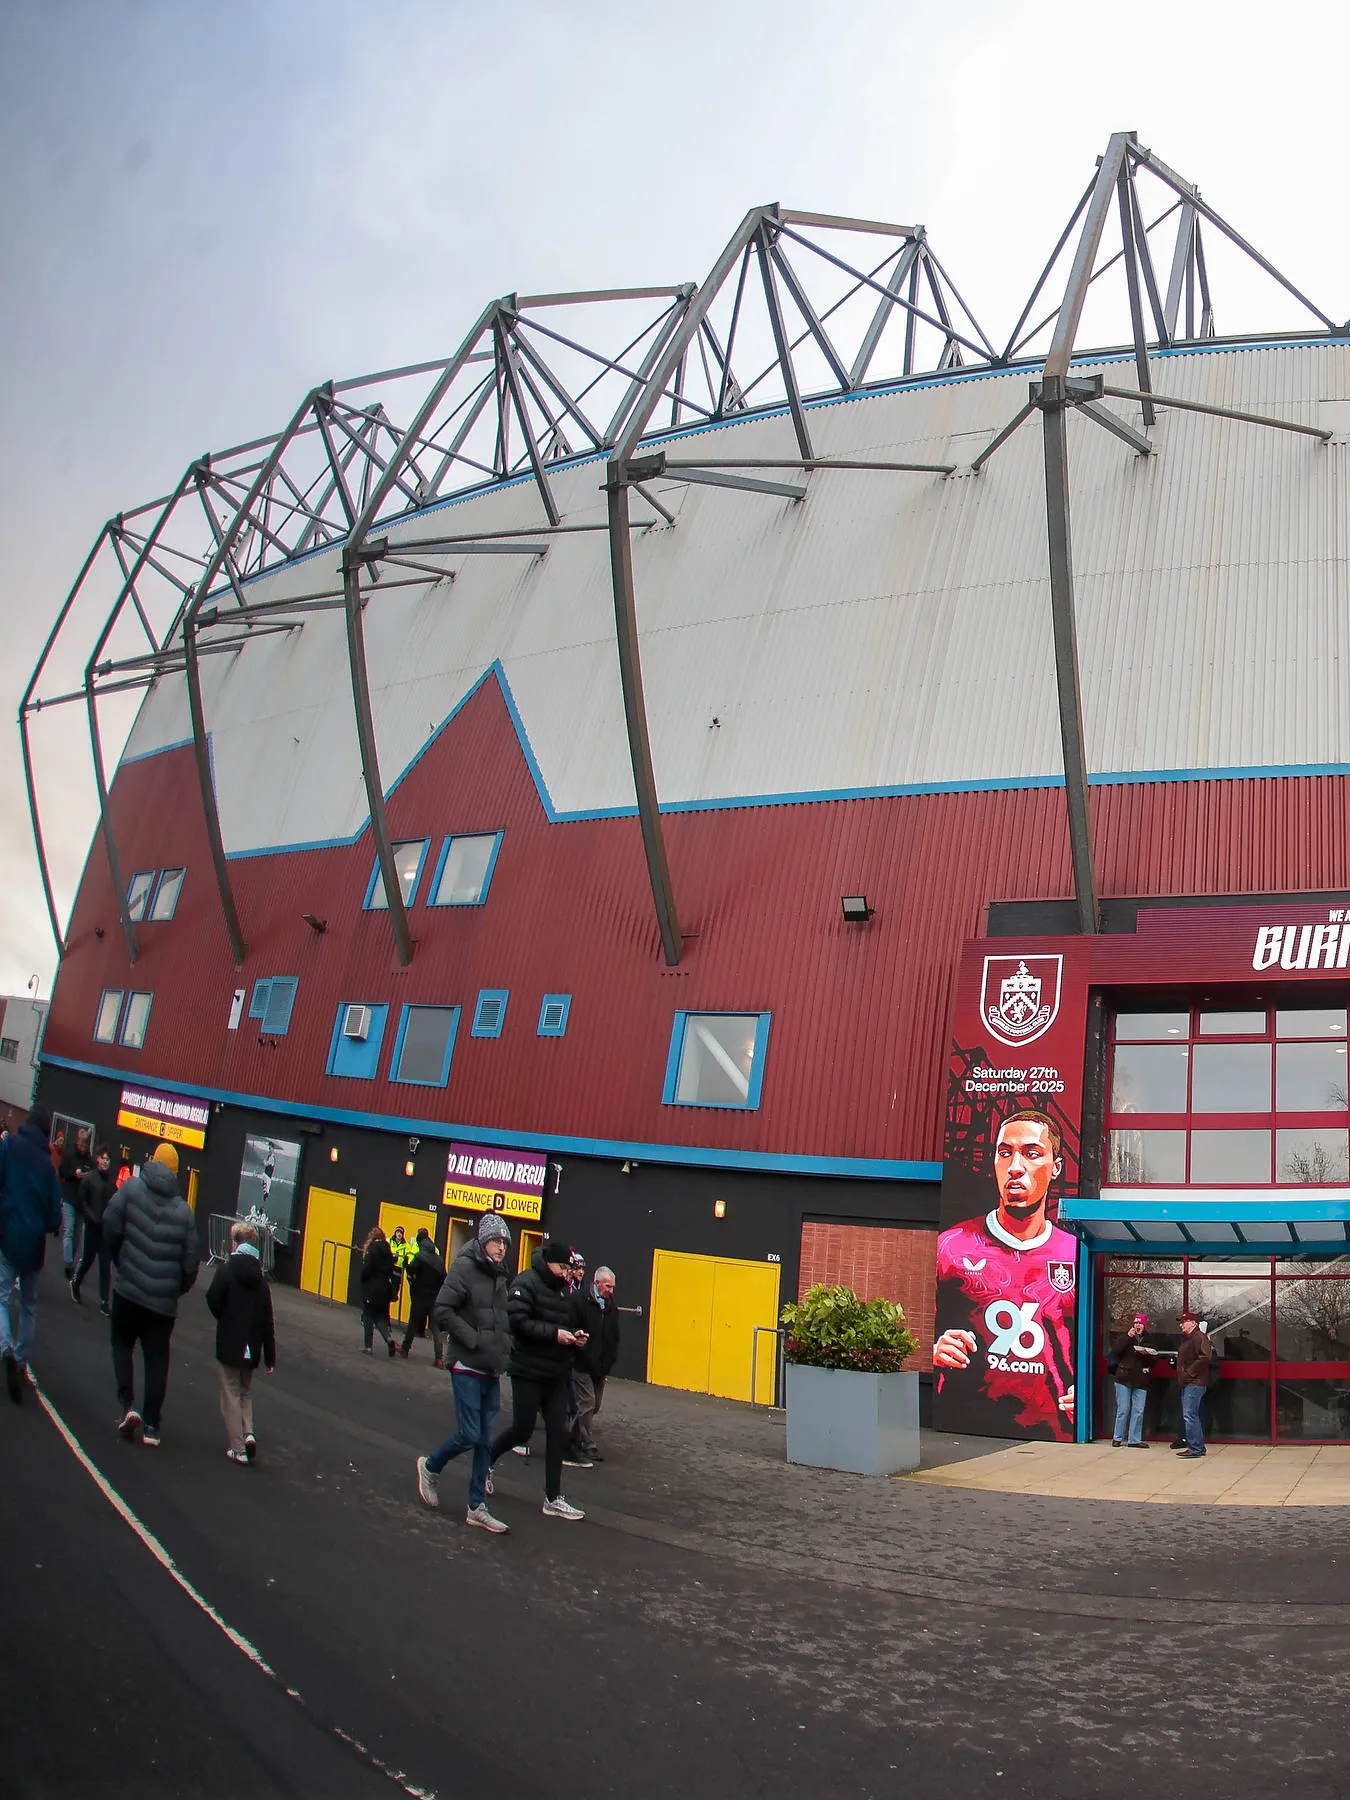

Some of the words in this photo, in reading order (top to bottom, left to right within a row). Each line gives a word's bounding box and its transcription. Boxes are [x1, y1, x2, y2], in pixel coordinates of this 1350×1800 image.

[1329, 909, 1344, 922] WE
[972, 1066, 1028, 1080] Saturday
[1029, 1066, 1058, 1078] 27th
[965, 1080, 1030, 1092] December
[1031, 1081, 1065, 1093] 2025
[456, 1155, 473, 1176] ALL
[473, 1158, 514, 1181] GROUND
[446, 1188, 493, 1206] ENTRANCE
[495, 1196, 503, 1208] D
[506, 1198, 539, 1214] LOWER
[767, 1253, 781, 1262] EX6
[984, 1300, 1045, 1359] 96
[987, 1354, 1045, 1374] 96.com
